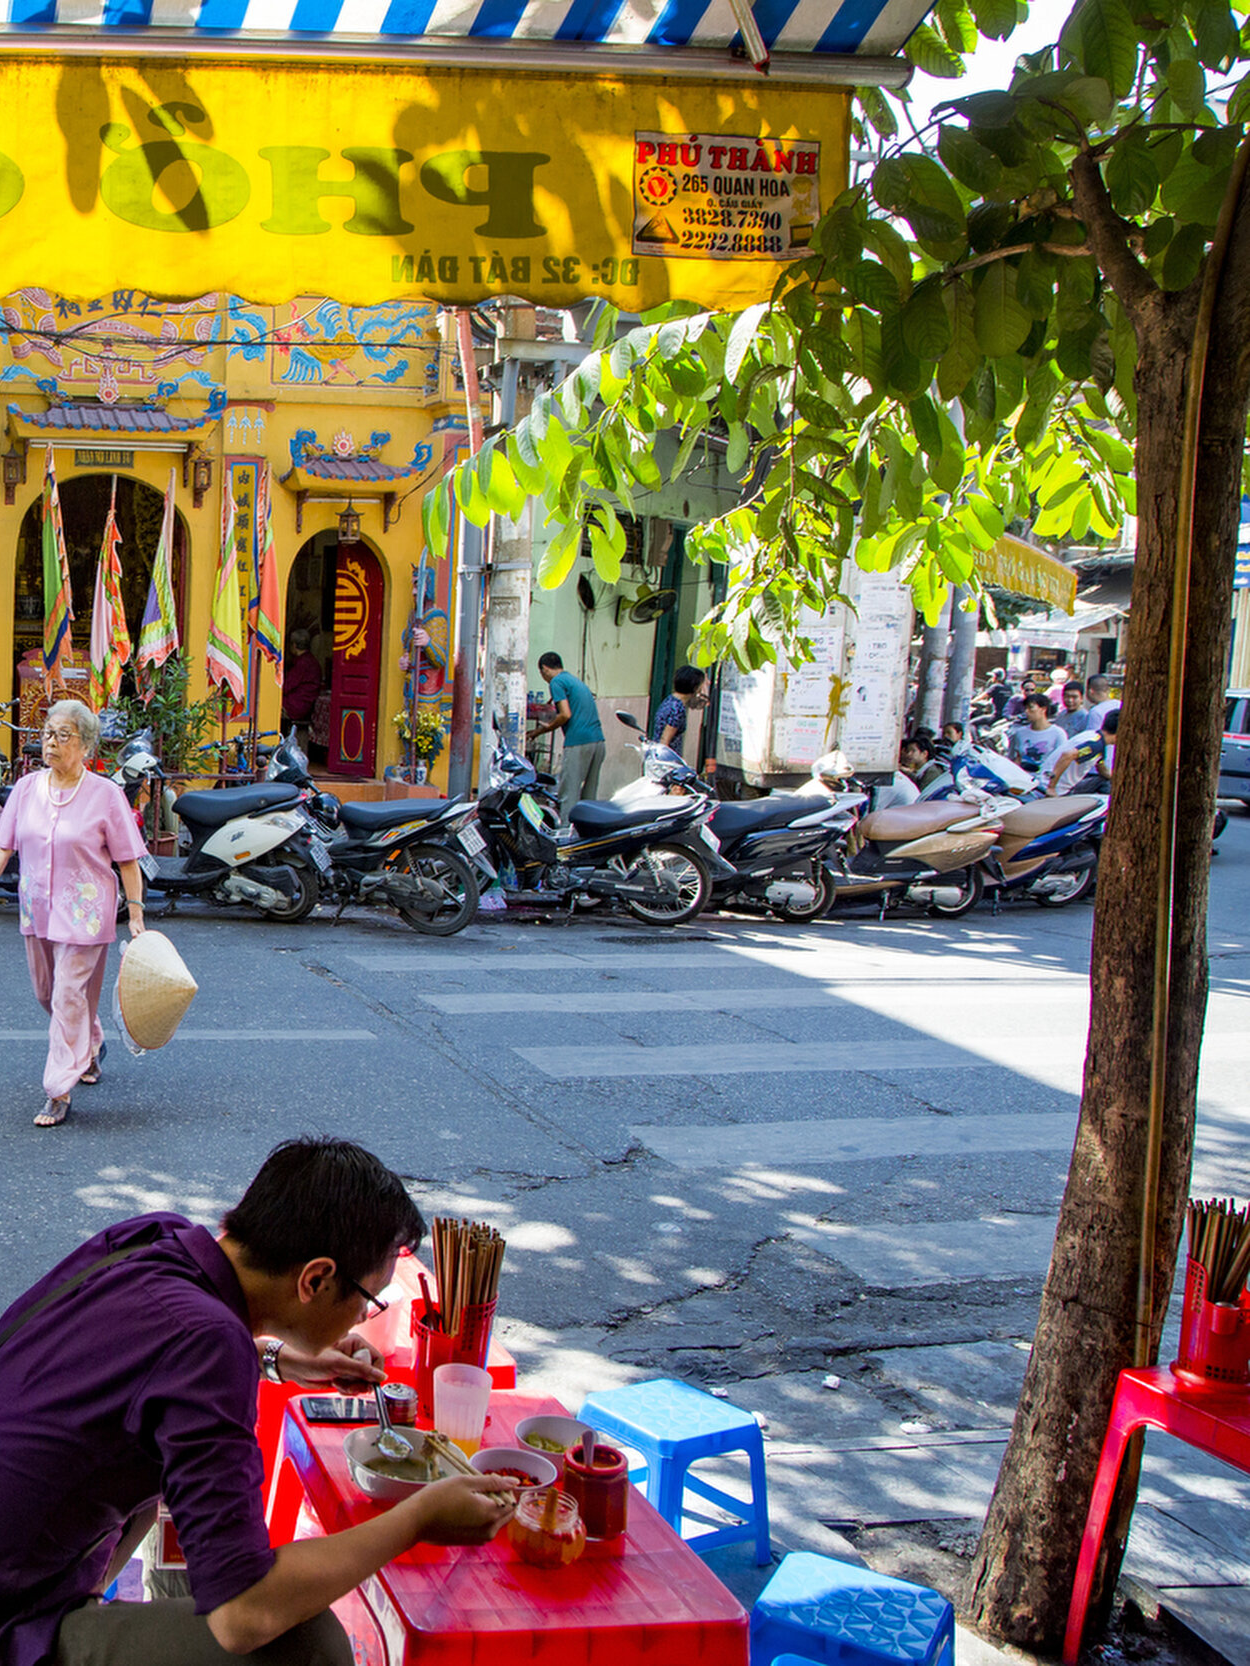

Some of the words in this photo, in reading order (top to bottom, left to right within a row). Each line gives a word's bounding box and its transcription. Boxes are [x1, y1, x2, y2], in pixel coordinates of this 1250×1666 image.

[636, 135, 703, 168] PHÚ
[708, 138, 818, 175] THÀNH
[681, 174, 709, 194] 265
[713, 176, 754, 197] QUAN
[760, 178, 791, 198] HOA
[682, 208, 782, 231] 3828.7390
[681, 230, 783, 253] 2232.8888
